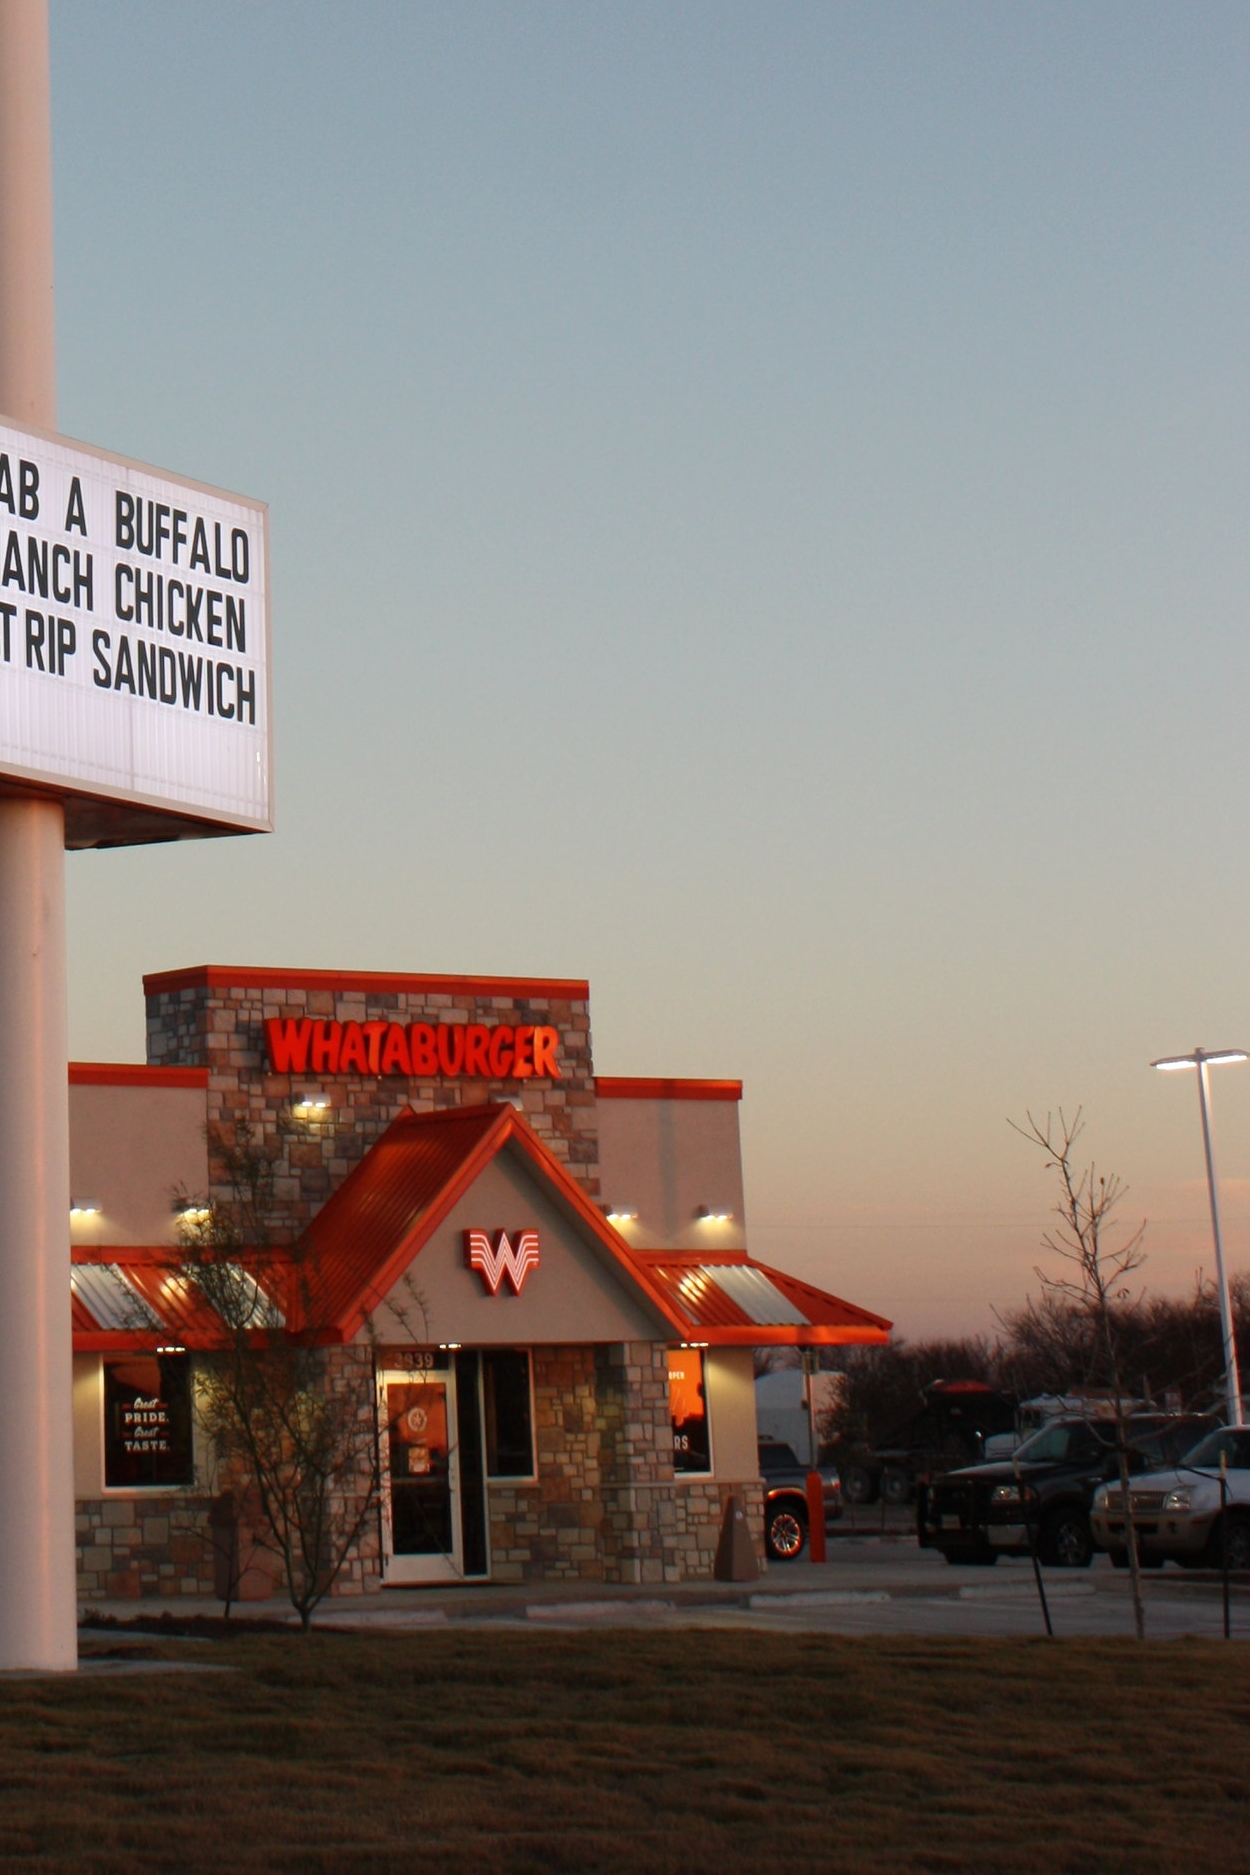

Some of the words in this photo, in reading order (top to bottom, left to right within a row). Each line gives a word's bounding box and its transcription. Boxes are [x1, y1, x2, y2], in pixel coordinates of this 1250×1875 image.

[64, 476, 88, 537] A
[115, 489, 250, 584] BUFFALO
[115, 562, 247, 653] CHICKEN
[92, 629, 256, 726] SANDWICH
[263, 1017, 562, 1080] WHATABURGER
